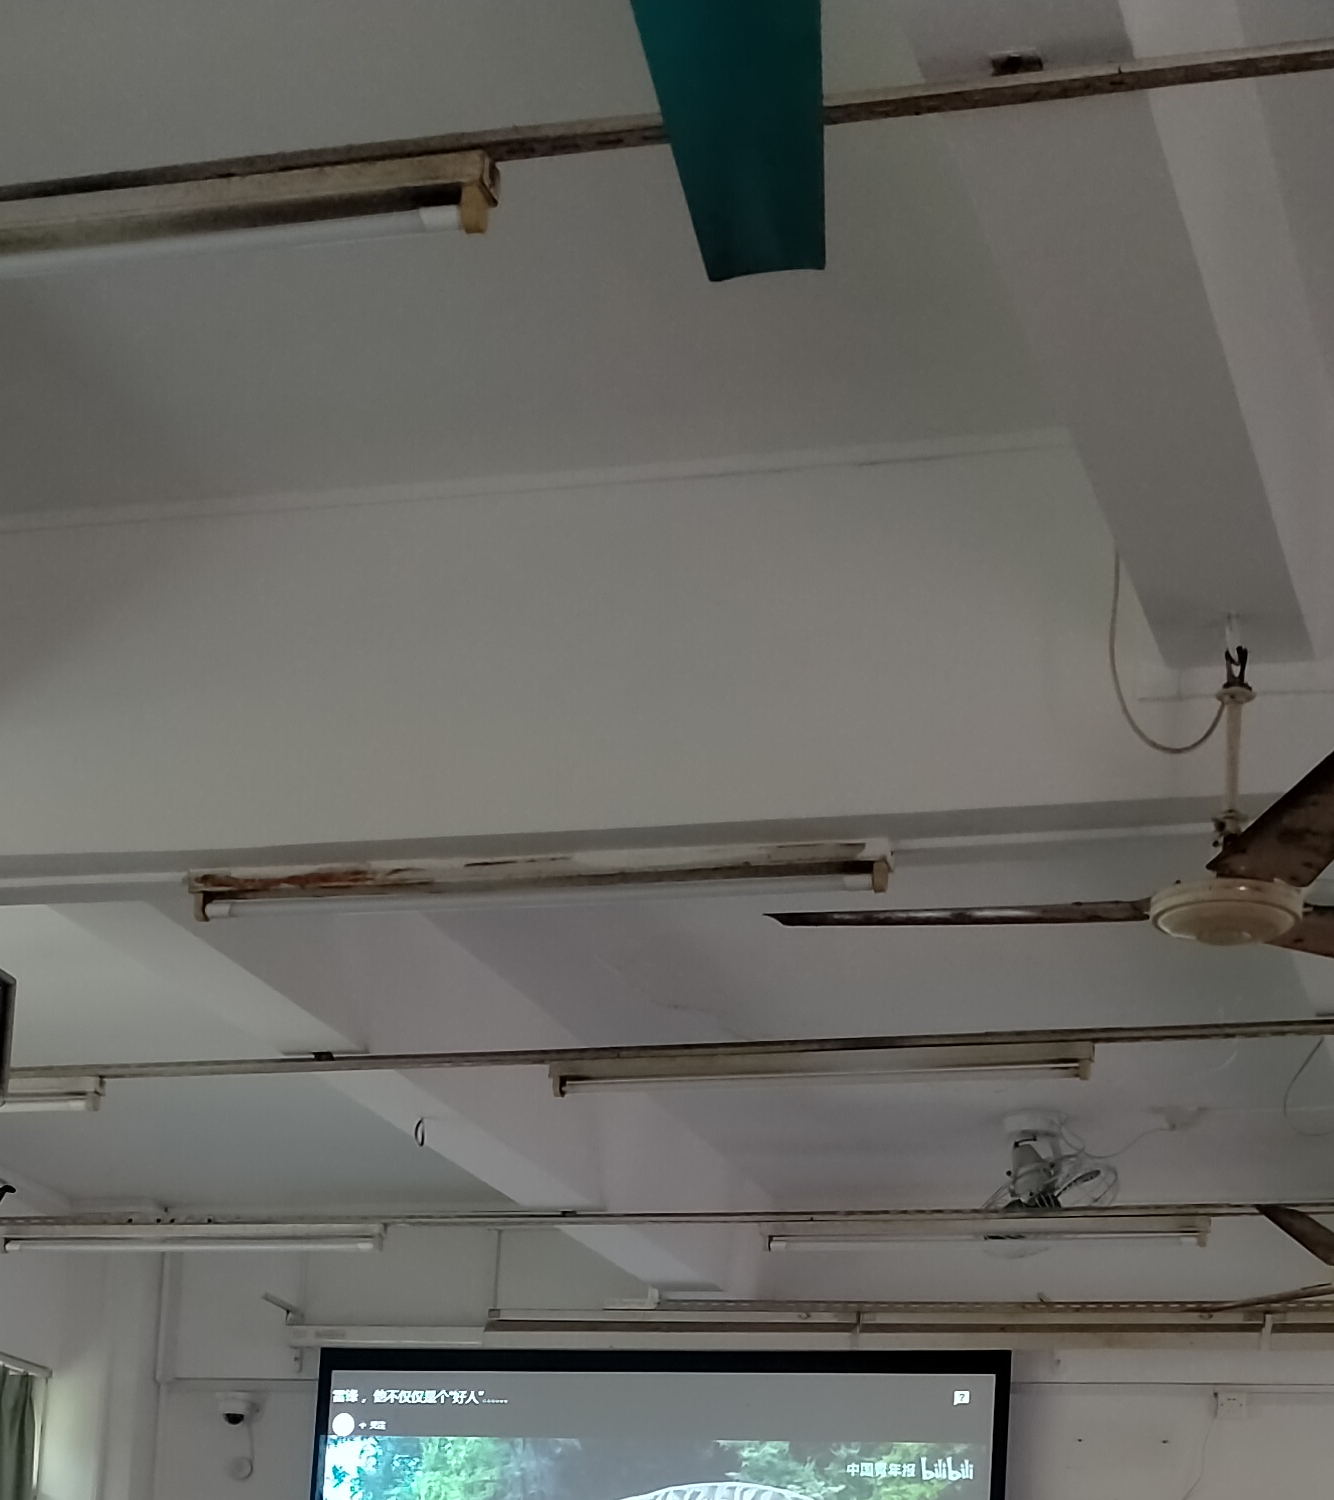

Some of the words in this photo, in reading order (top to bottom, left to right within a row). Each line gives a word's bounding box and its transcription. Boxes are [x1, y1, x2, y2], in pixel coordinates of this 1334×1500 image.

[846, 1462, 916, 1477] 中国青年报
[921, 1457, 974, 1481] bilibili
